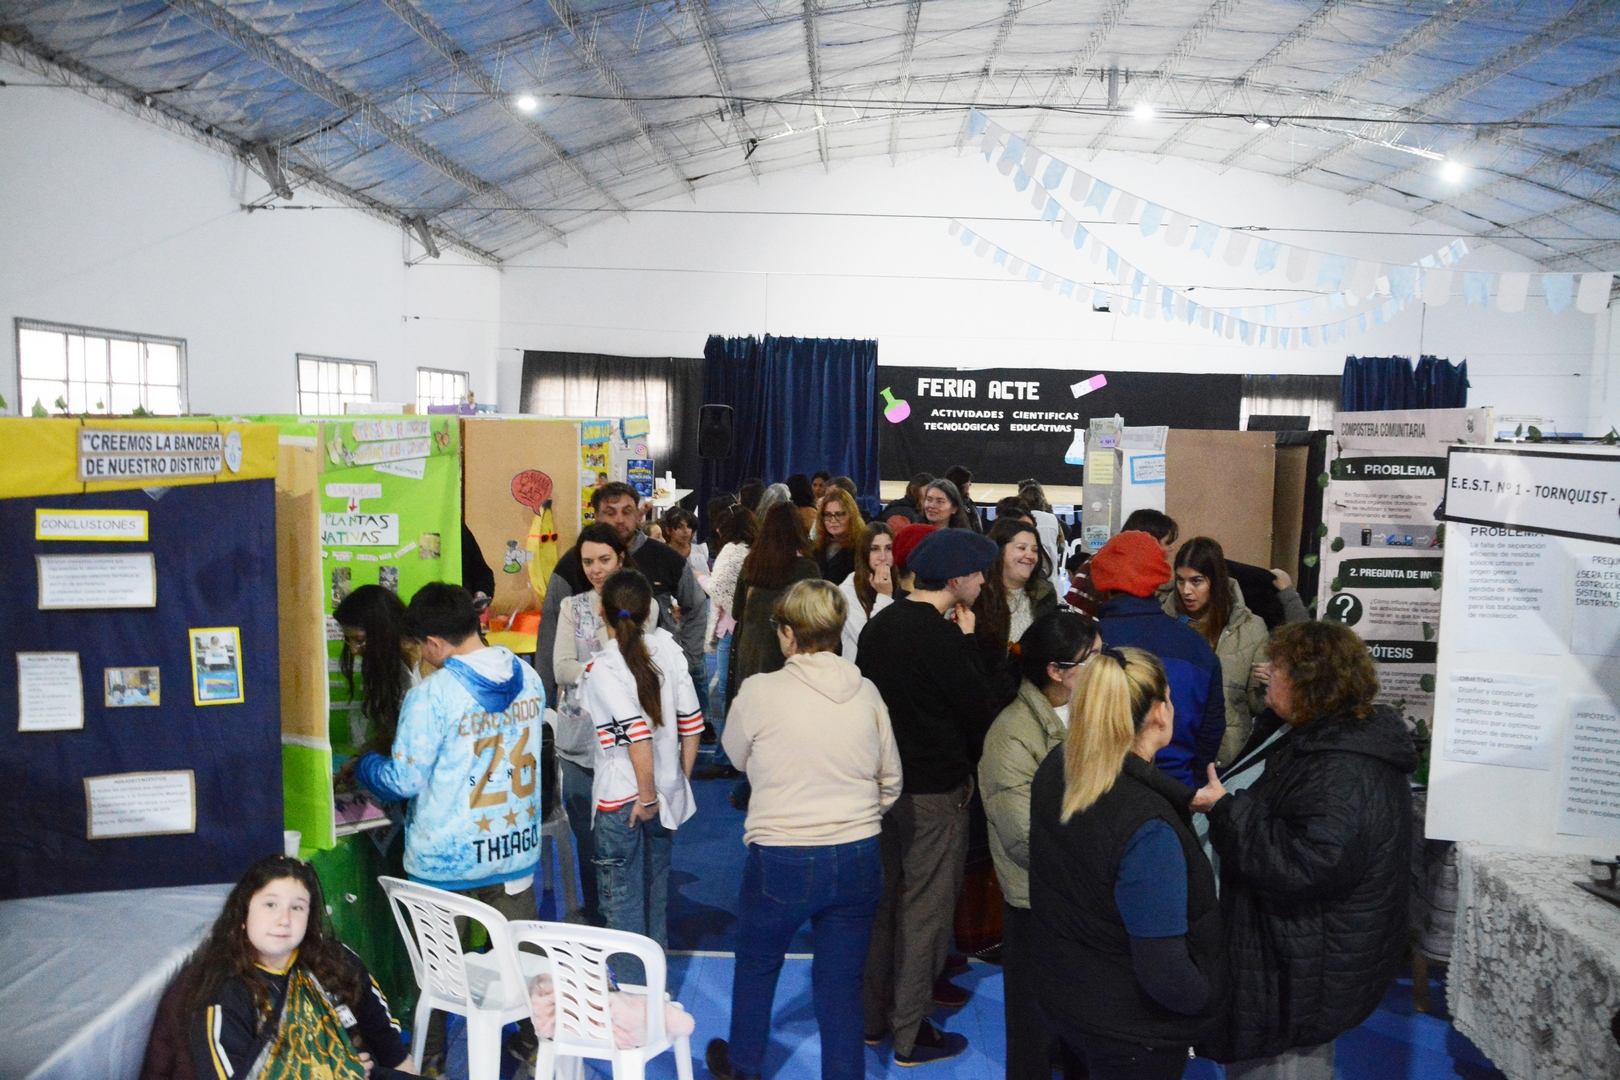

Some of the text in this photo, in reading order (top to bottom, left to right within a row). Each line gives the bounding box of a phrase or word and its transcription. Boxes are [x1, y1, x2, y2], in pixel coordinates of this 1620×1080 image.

[917, 377, 1040, 401] FERIA ACTE
[930, 408, 1080, 421] ACTIVIDADES CIENTIFICAS
[923, 422, 1072, 433] TECNOLOGICAS EDUCATIVAS
[1341, 423, 1426, 438] COMPOSTERA COMUNITARIA
[83, 434, 220, 451] "CREEMOS LA BANDERA
[86, 456, 220, 475] DE NUESTRO DISTRITO"
[1345, 464, 1436, 476] 1. PROBLEMA
[1451, 477, 1492, 493] E.E.S.T.
[1515, 483, 1522, 496] 1
[1534, 485, 1608, 504] TORNQUIST
[41, 519, 136, 530] CONCLUSIONES
[325, 513, 390, 529] PLANTAS
[1507, 542, 1546, 550] separación
[1350, 568, 1358, 577] 2.
[1359, 568, 1404, 578] PREGUNTA
[1406, 570, 1418, 579] DE
[1458, 686, 1484, 694] Diseñar
[1491, 689, 1523, 698] construir
[1457, 697, 1490, 705] prototipo
[1502, 701, 1538, 709] separador
[1456, 707, 1492, 716] magnético
[1504, 711, 1535, 719] residuos
[1455, 717, 1488, 726] metálicos
[1507, 722, 1541, 730] optimizar
[613, 726, 625, 736] 23
[1462, 728, 1488, 736] gestión
[1500, 731, 1533, 740] desechos
[1453, 738, 1488, 746] promover
[1497, 742, 1533, 751] economía
[1573, 745, 1614, 754] separación
[1580, 756, 1603, 764] punto
[469, 726, 537, 809] 26
[472, 824, 539, 863] THIAGO
